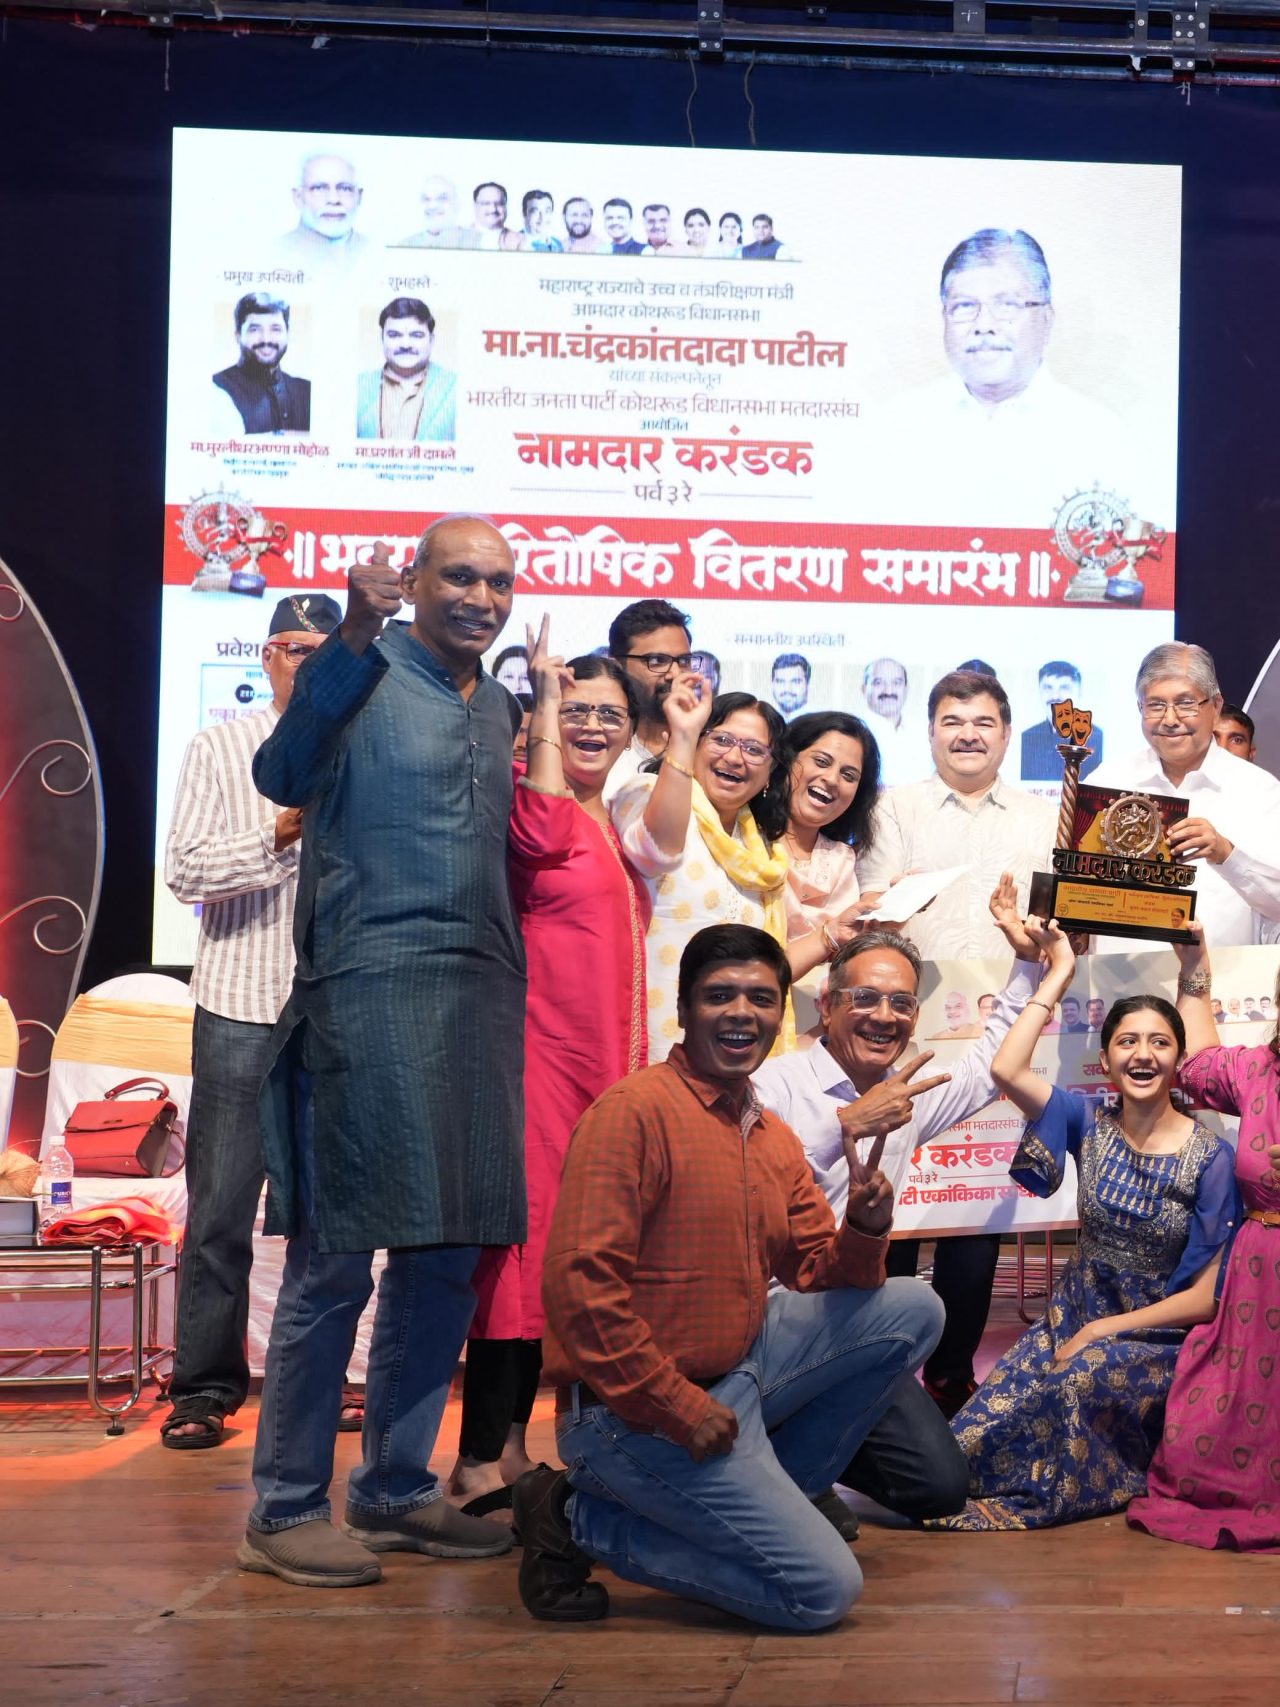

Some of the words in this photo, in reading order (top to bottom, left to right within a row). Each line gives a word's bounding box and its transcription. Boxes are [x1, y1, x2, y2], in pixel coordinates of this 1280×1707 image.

[223, 269, 253, 286] प्रमुख
[388, 275, 431, 291] शुभहस्ते
[539, 278, 594, 297] महाराष्ट्र
[595, 278, 645, 296] राज्याचे
[648, 281, 675, 297] उच्च
[679, 284, 690, 298] व
[692, 281, 763, 300] तंत्रशिक्षण
[767, 282, 794, 300] मंत्री
[571, 302, 625, 319] आमदार
[628, 303, 686, 321] कोथरूड
[689, 304, 761, 323] विधानसभा
[482, 324, 746, 366] मा.ना.चंद्रकांतदादा
[752, 330, 848, 368] पाटील
[648, 368, 723, 390] संकल्पनेतून
[466, 387, 526, 409] भारतीय
[530, 391, 577, 411] जनता
[580, 387, 616, 411] पार्टी
[619, 391, 688, 414] कोथरूड
[692, 393, 776, 417] विधानसभा
[779, 397, 861, 419] मतदारसंघ
[639, 417, 690, 433] आयोजित
[513, 431, 664, 474] नामदार
[671, 424, 814, 477] करंडक
[633, 479, 664, 502] पर्व
[499, 521, 681, 589] रितोषिक
[687, 527, 848, 593] वितरण
[1052, 848, 1126, 880] नामदार
[1130, 852, 1197, 887] करंडक
[973, 1116, 1020, 1132] मतदारसंघ
[908, 1171, 924, 1184] पर्व
[920, 1183, 996, 1202] एकांकिका
